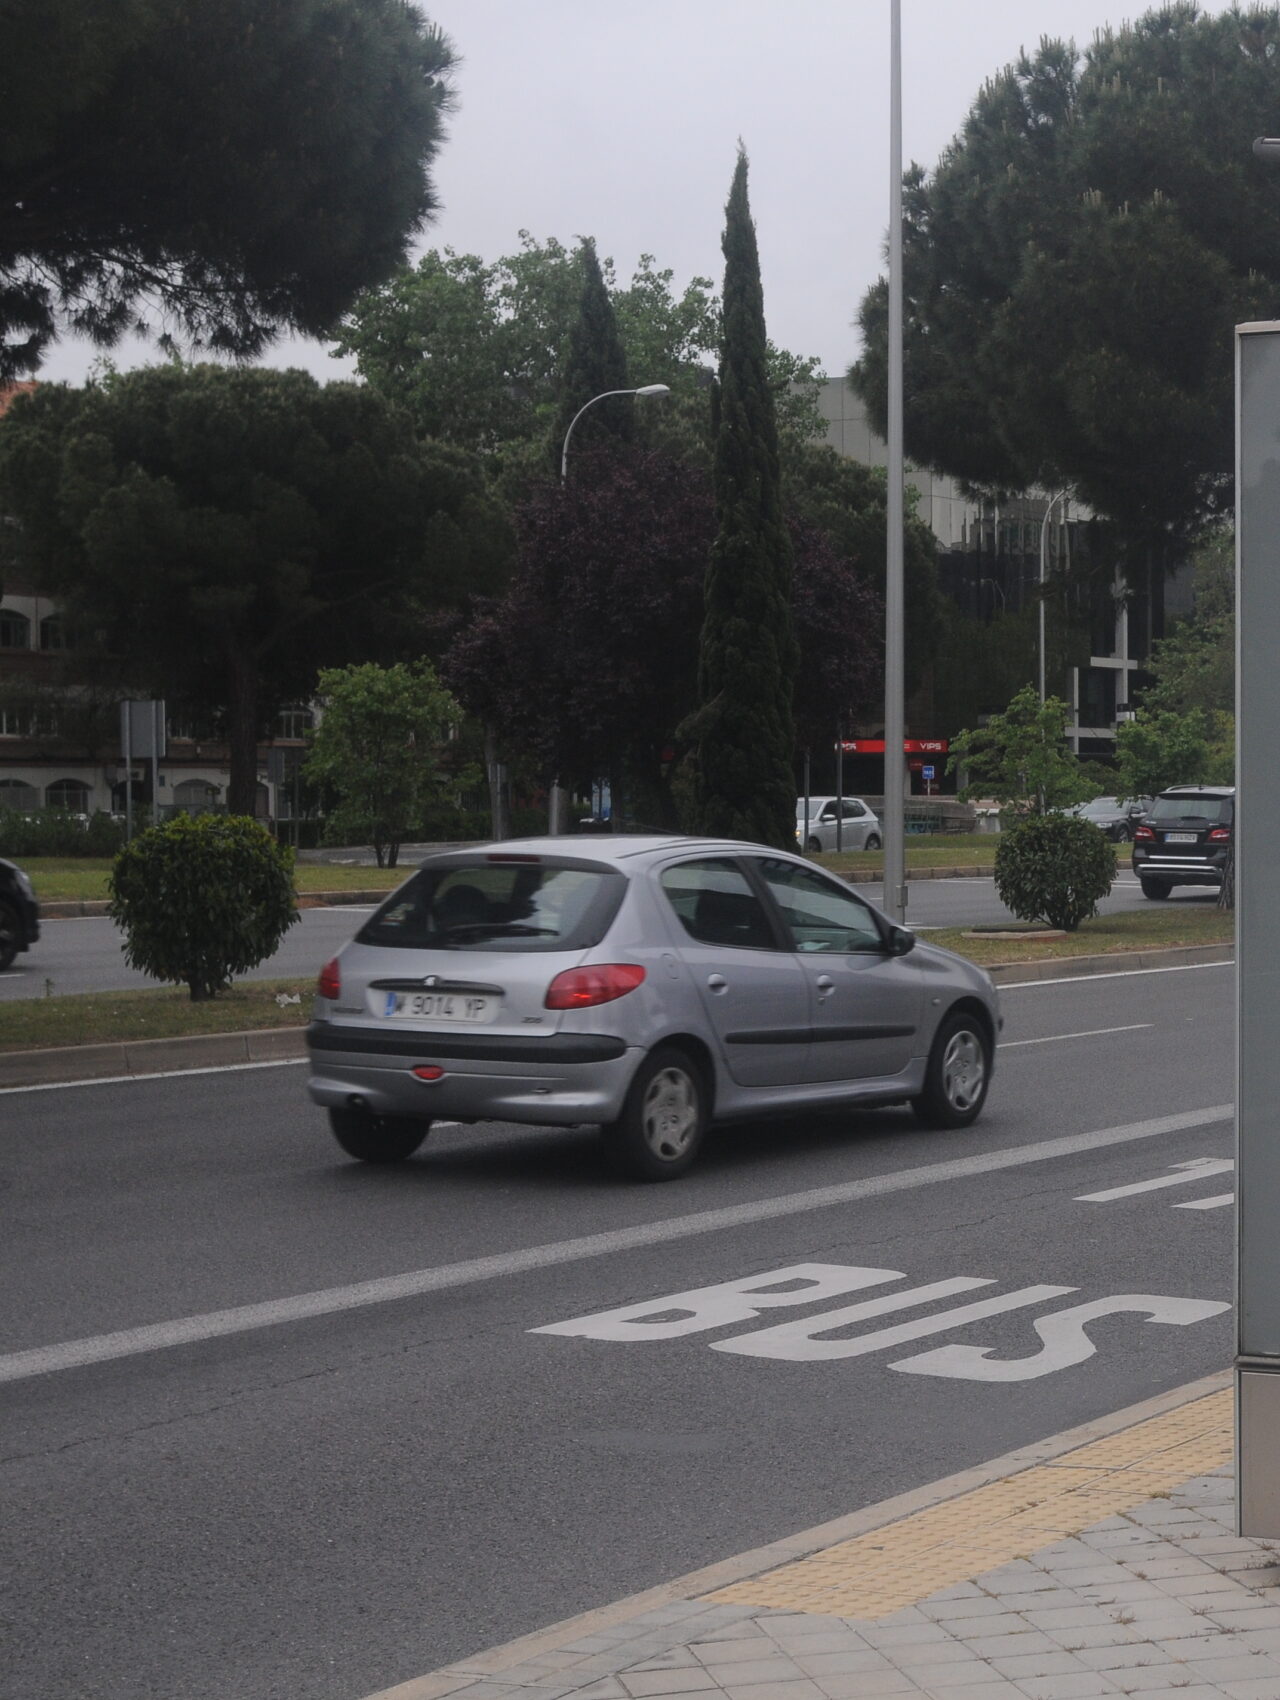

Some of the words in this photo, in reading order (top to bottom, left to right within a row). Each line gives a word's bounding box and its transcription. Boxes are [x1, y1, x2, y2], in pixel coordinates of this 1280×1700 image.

[919, 742, 942, 750] VIPS
[411, 996, 454, 1016] 9014
[523, 1262, 1232, 1382] BUS
